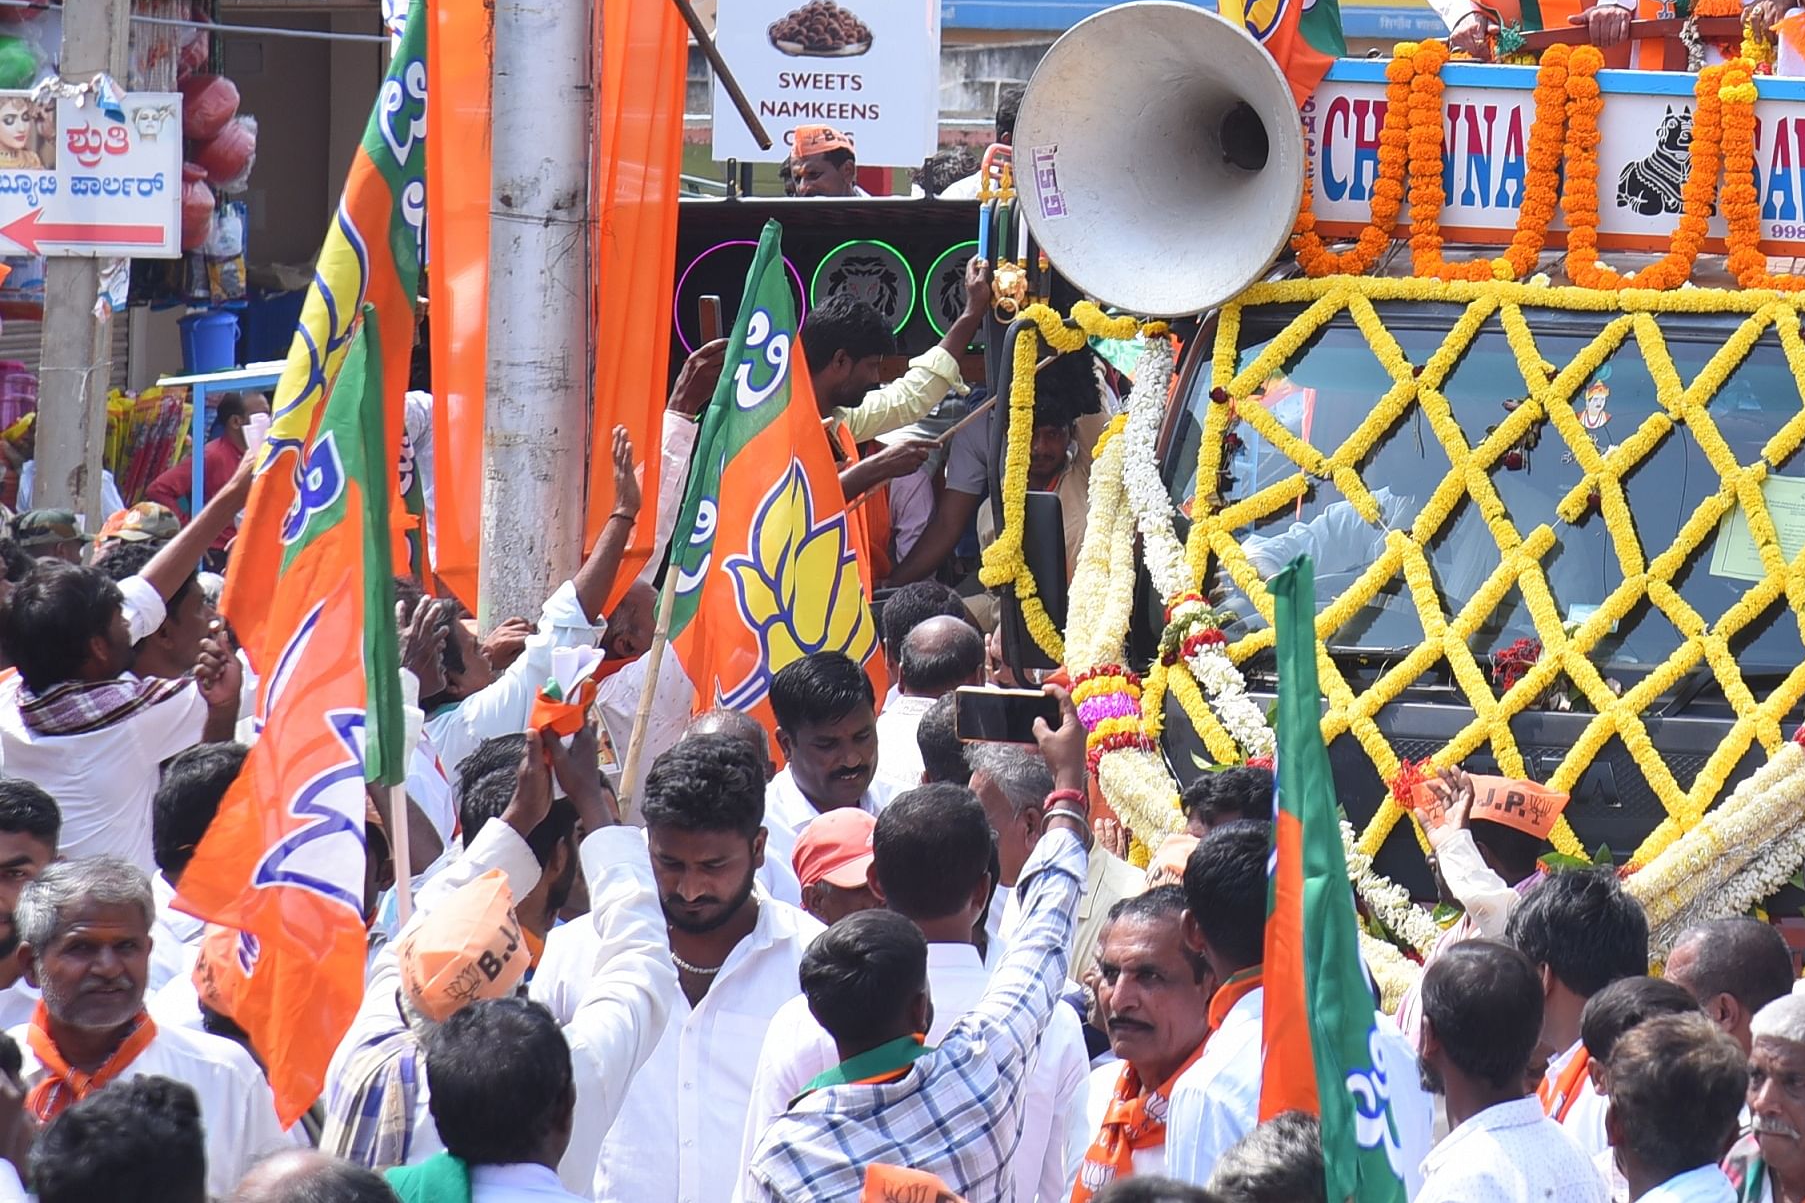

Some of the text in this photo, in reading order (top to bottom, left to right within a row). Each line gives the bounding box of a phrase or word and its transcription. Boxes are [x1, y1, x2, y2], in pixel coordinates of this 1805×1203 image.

[779, 72, 862, 92] SWEETS
[759, 100, 880, 121] NAMKEENS
[1475, 788, 1526, 817] J.P.
